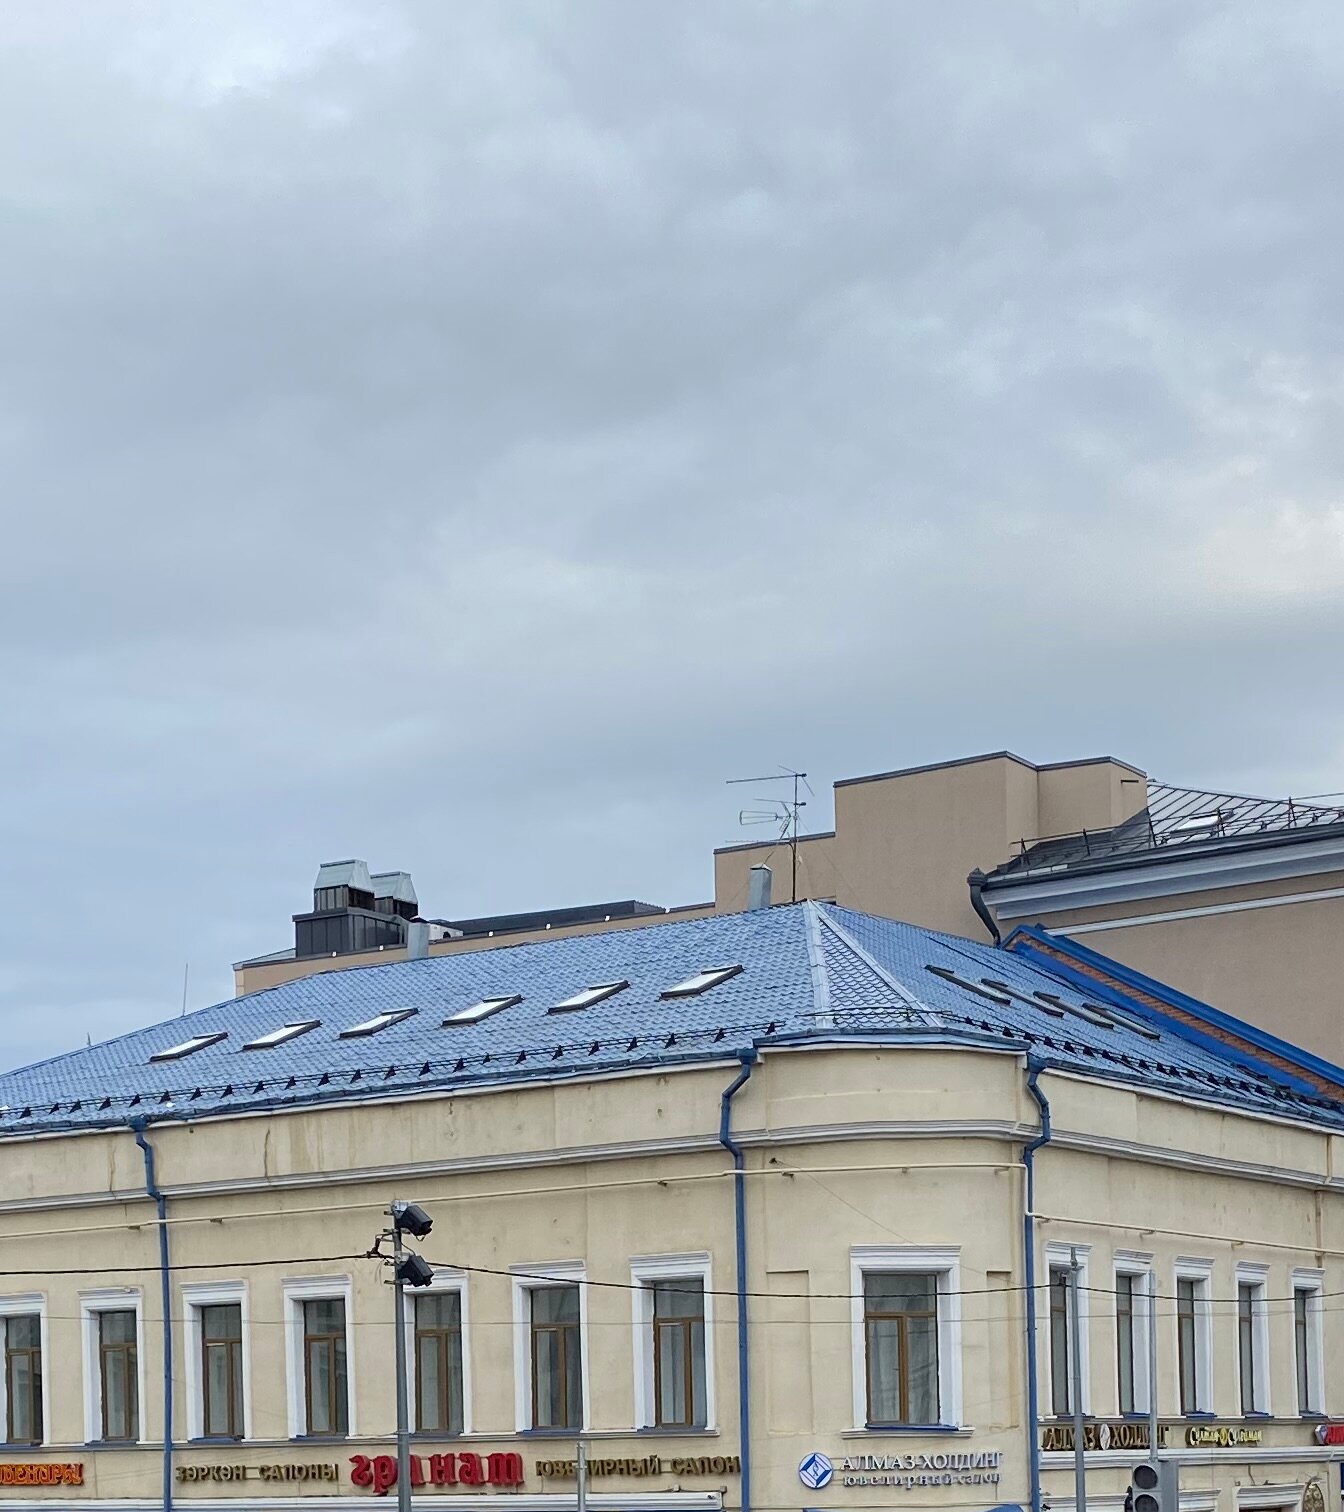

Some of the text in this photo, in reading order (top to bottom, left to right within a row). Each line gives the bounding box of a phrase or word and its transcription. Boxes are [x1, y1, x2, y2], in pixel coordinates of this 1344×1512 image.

[1042, 1424, 1096, 1452] АЛМЗ
[258, 1462, 339, 1481] САЛОНЫ
[535, 1454, 742, 1478] ЮВЕИРНЫЙ САЛОН
